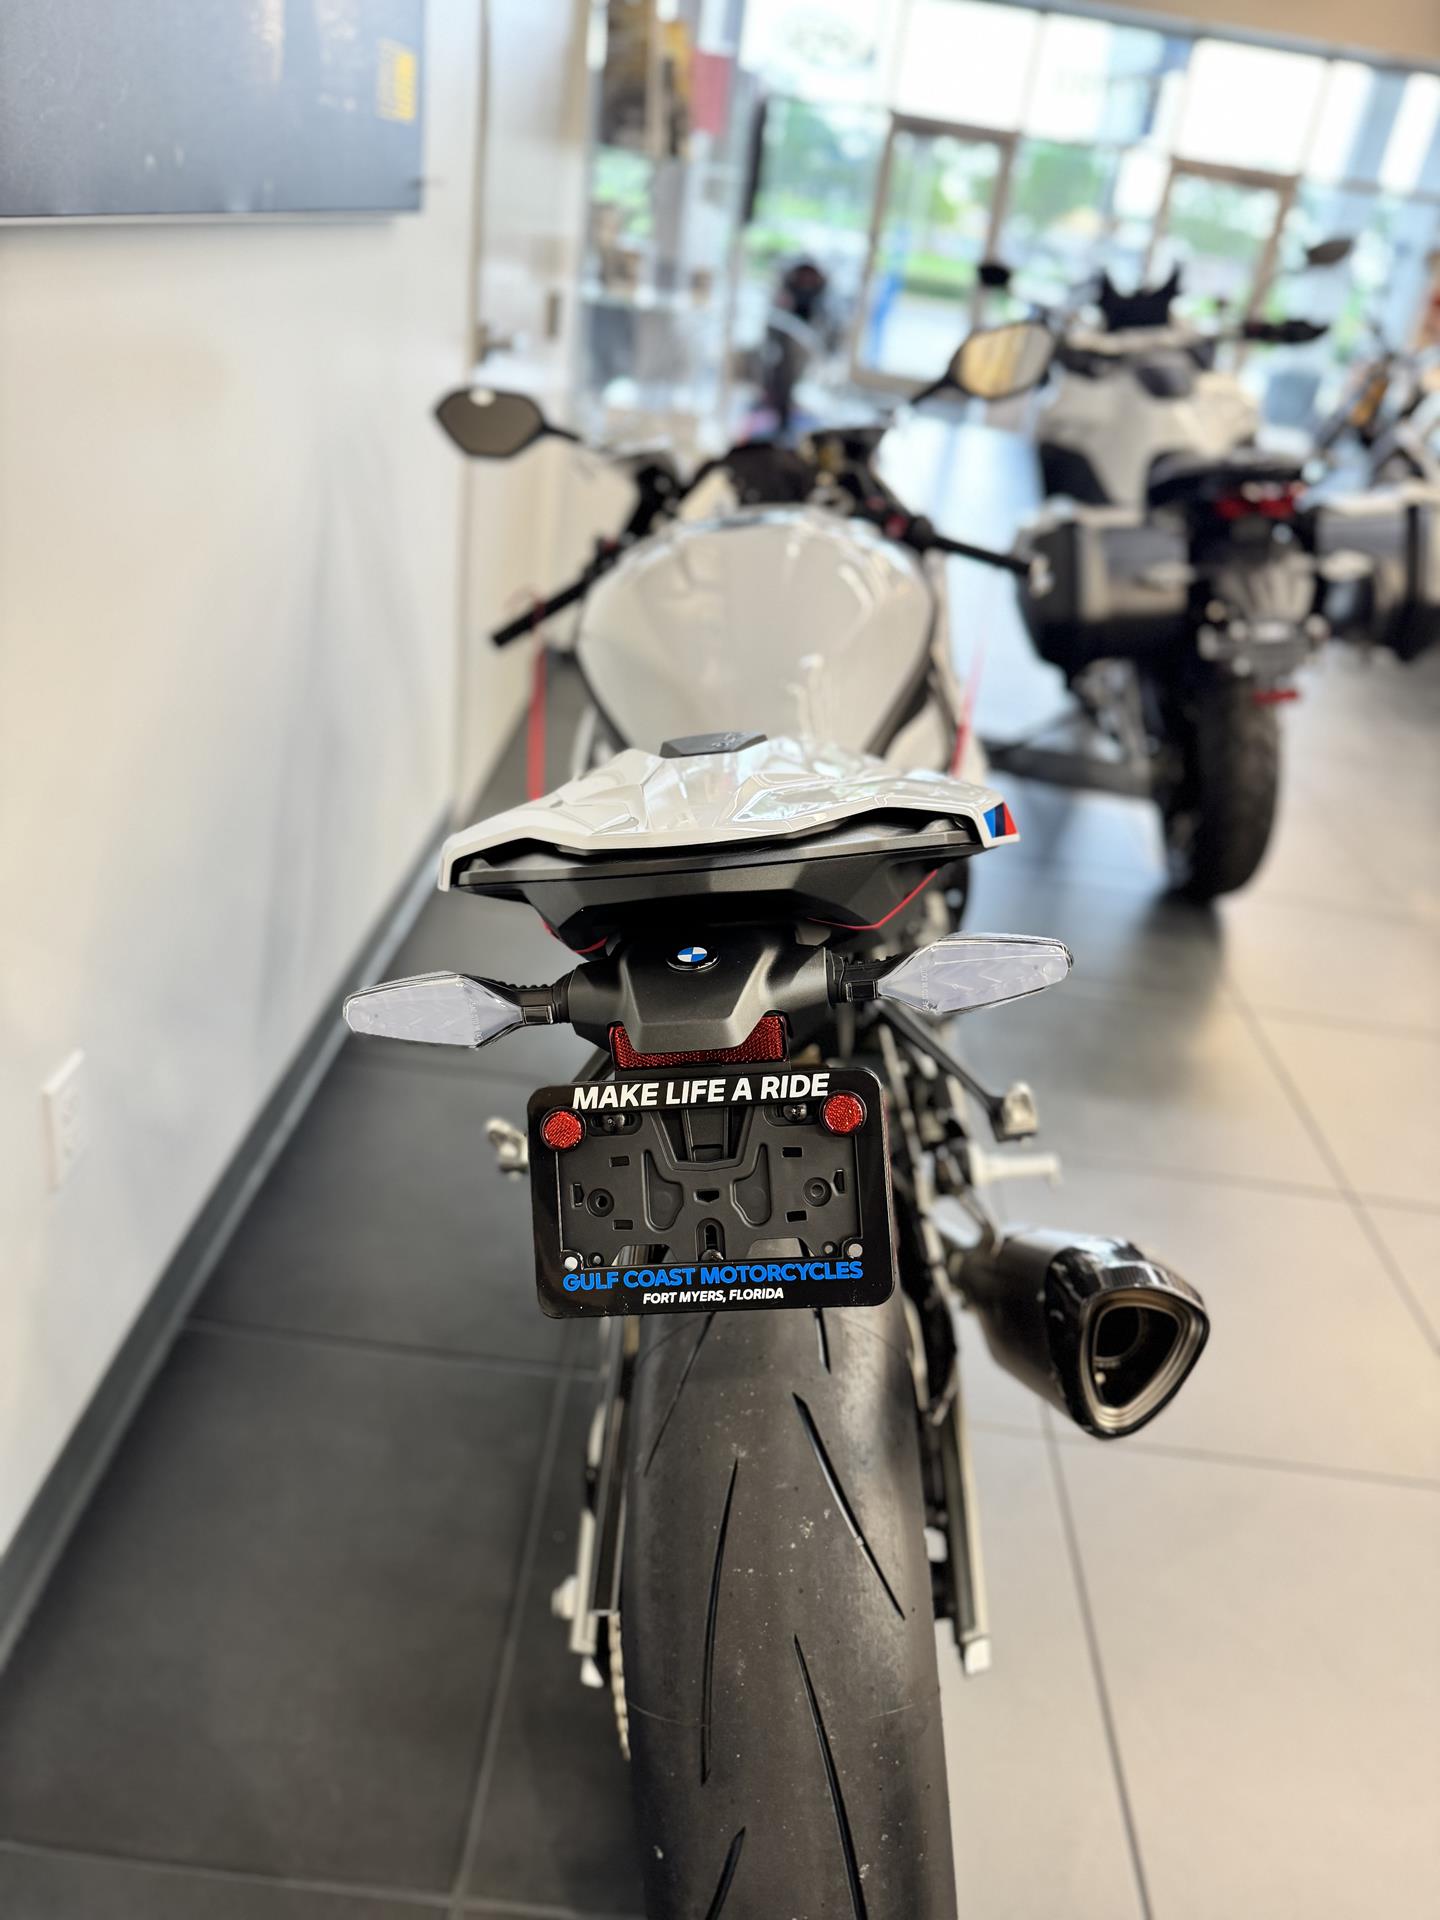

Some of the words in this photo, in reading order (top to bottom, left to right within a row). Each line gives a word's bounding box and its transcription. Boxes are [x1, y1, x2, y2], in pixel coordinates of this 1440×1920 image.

[572, 1082, 660, 1110] MAKE
[666, 1079, 727, 1104] LIFE
[731, 1077, 753, 1101] A
[760, 1073, 830, 1099] RIDE
[563, 1272, 619, 1292] GULF
[622, 1267, 697, 1288] COAST
[700, 1261, 864, 1285] MOTORCYCLES
[643, 1291, 677, 1305] FORT
[679, 1289, 727, 1303] MYERS,
[729, 1287, 784, 1301] FLORIDA
